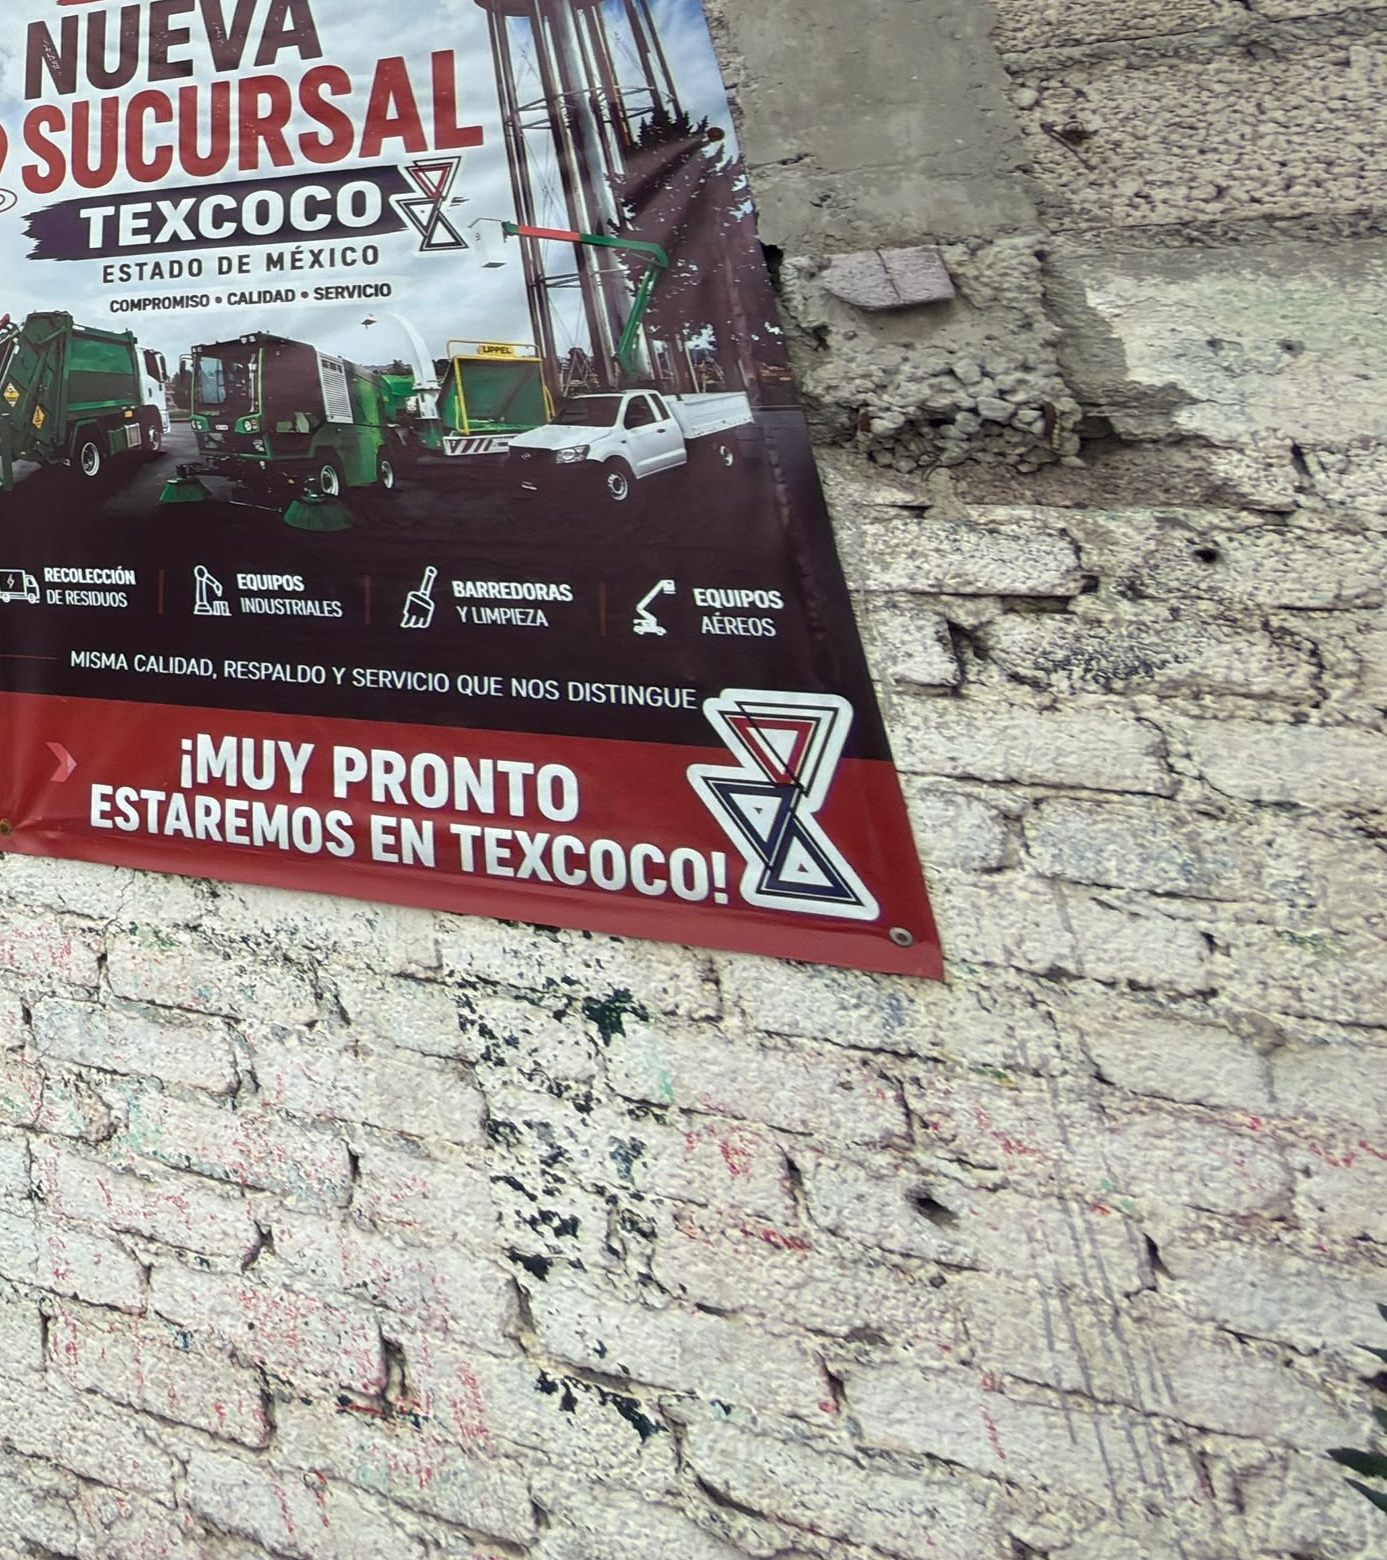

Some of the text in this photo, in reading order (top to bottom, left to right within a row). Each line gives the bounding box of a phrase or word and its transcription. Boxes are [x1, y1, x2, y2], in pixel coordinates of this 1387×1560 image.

[21, 49, 484, 194] SUCURSAL
[80, 181, 382, 249] TEXCOCO
[103, 244, 378, 283] ESTADO DE MÉXICO
[109, 283, 391, 313] COMPROMISO CALIDAD SERVICIO
[44, 566, 136, 585] RECOLECCIÓN
[237, 574, 304, 591] EQUIPOS
[46, 589, 128, 607] DE RESIDUOS
[452, 580, 573, 602] BARREDORAS
[693, 588, 784, 610] EQUIPOS
[240, 597, 343, 617] INDUSTRIALES
[456, 606, 549, 628] Y LIMPIEZA
[701, 611, 776, 637] AÉREOS
[71, 650, 698, 709] MISMA CALIDAD, RESPALDO Y SERVICIO QUE NOS DISTINGUE
[180, 733, 580, 823] ¡MUY PRONTO
[90, 784, 728, 905] ESTAREMOS EN TEXCOCO!
